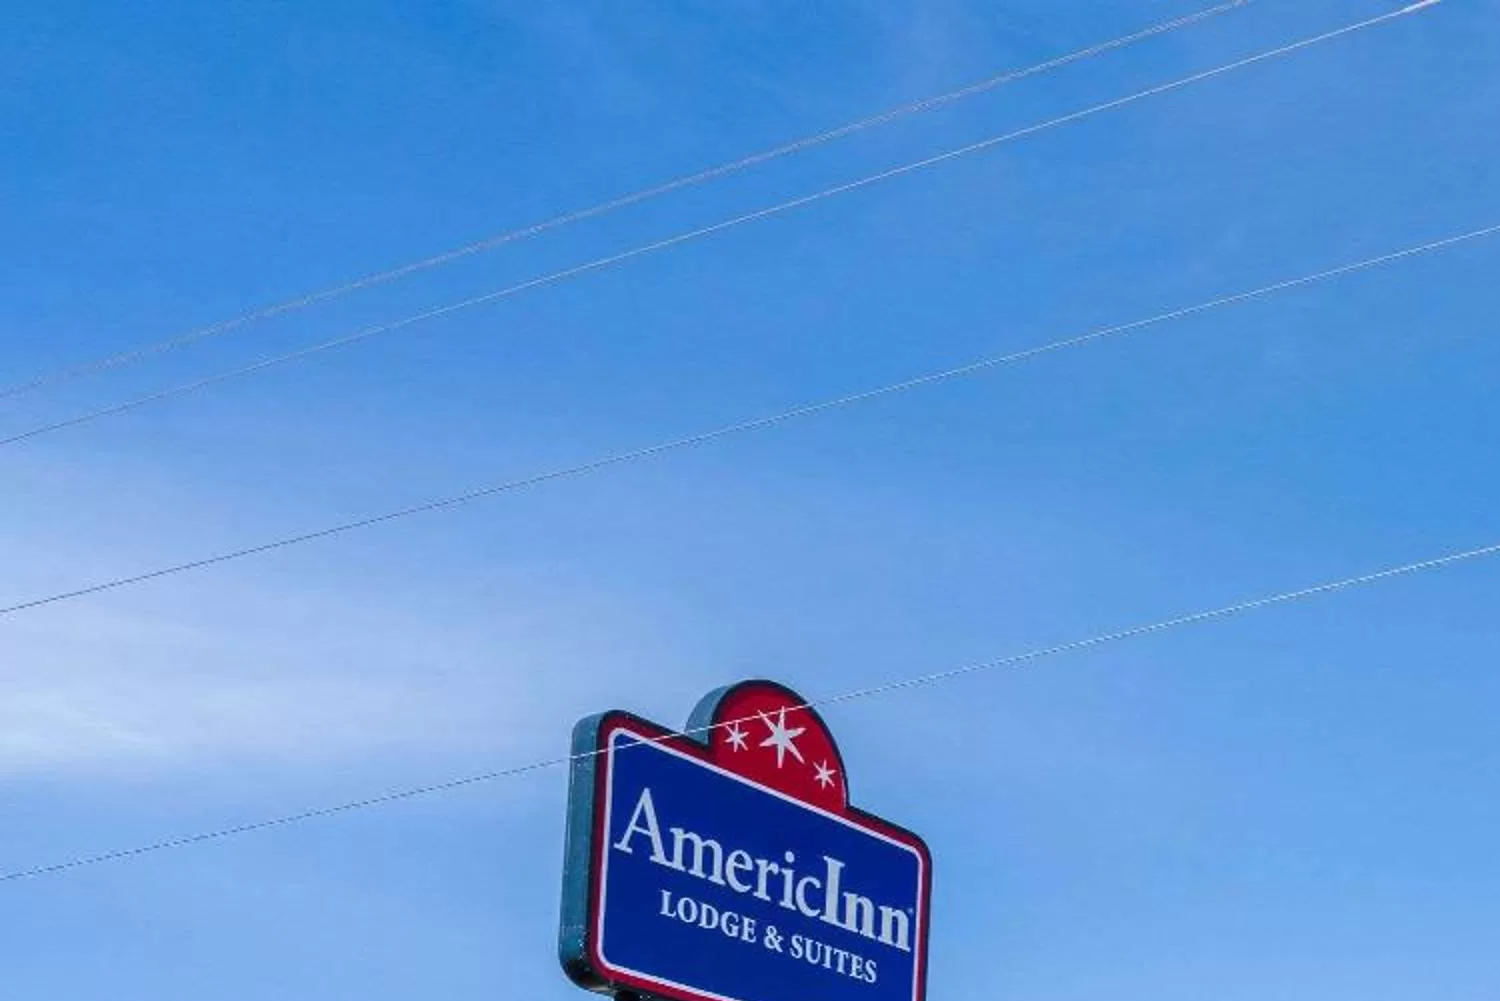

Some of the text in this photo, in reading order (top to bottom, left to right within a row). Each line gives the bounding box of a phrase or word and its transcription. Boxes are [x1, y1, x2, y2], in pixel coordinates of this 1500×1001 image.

[614, 787, 911, 952] AmericInn
[659, 889, 877, 985] LODGE & SUITES
